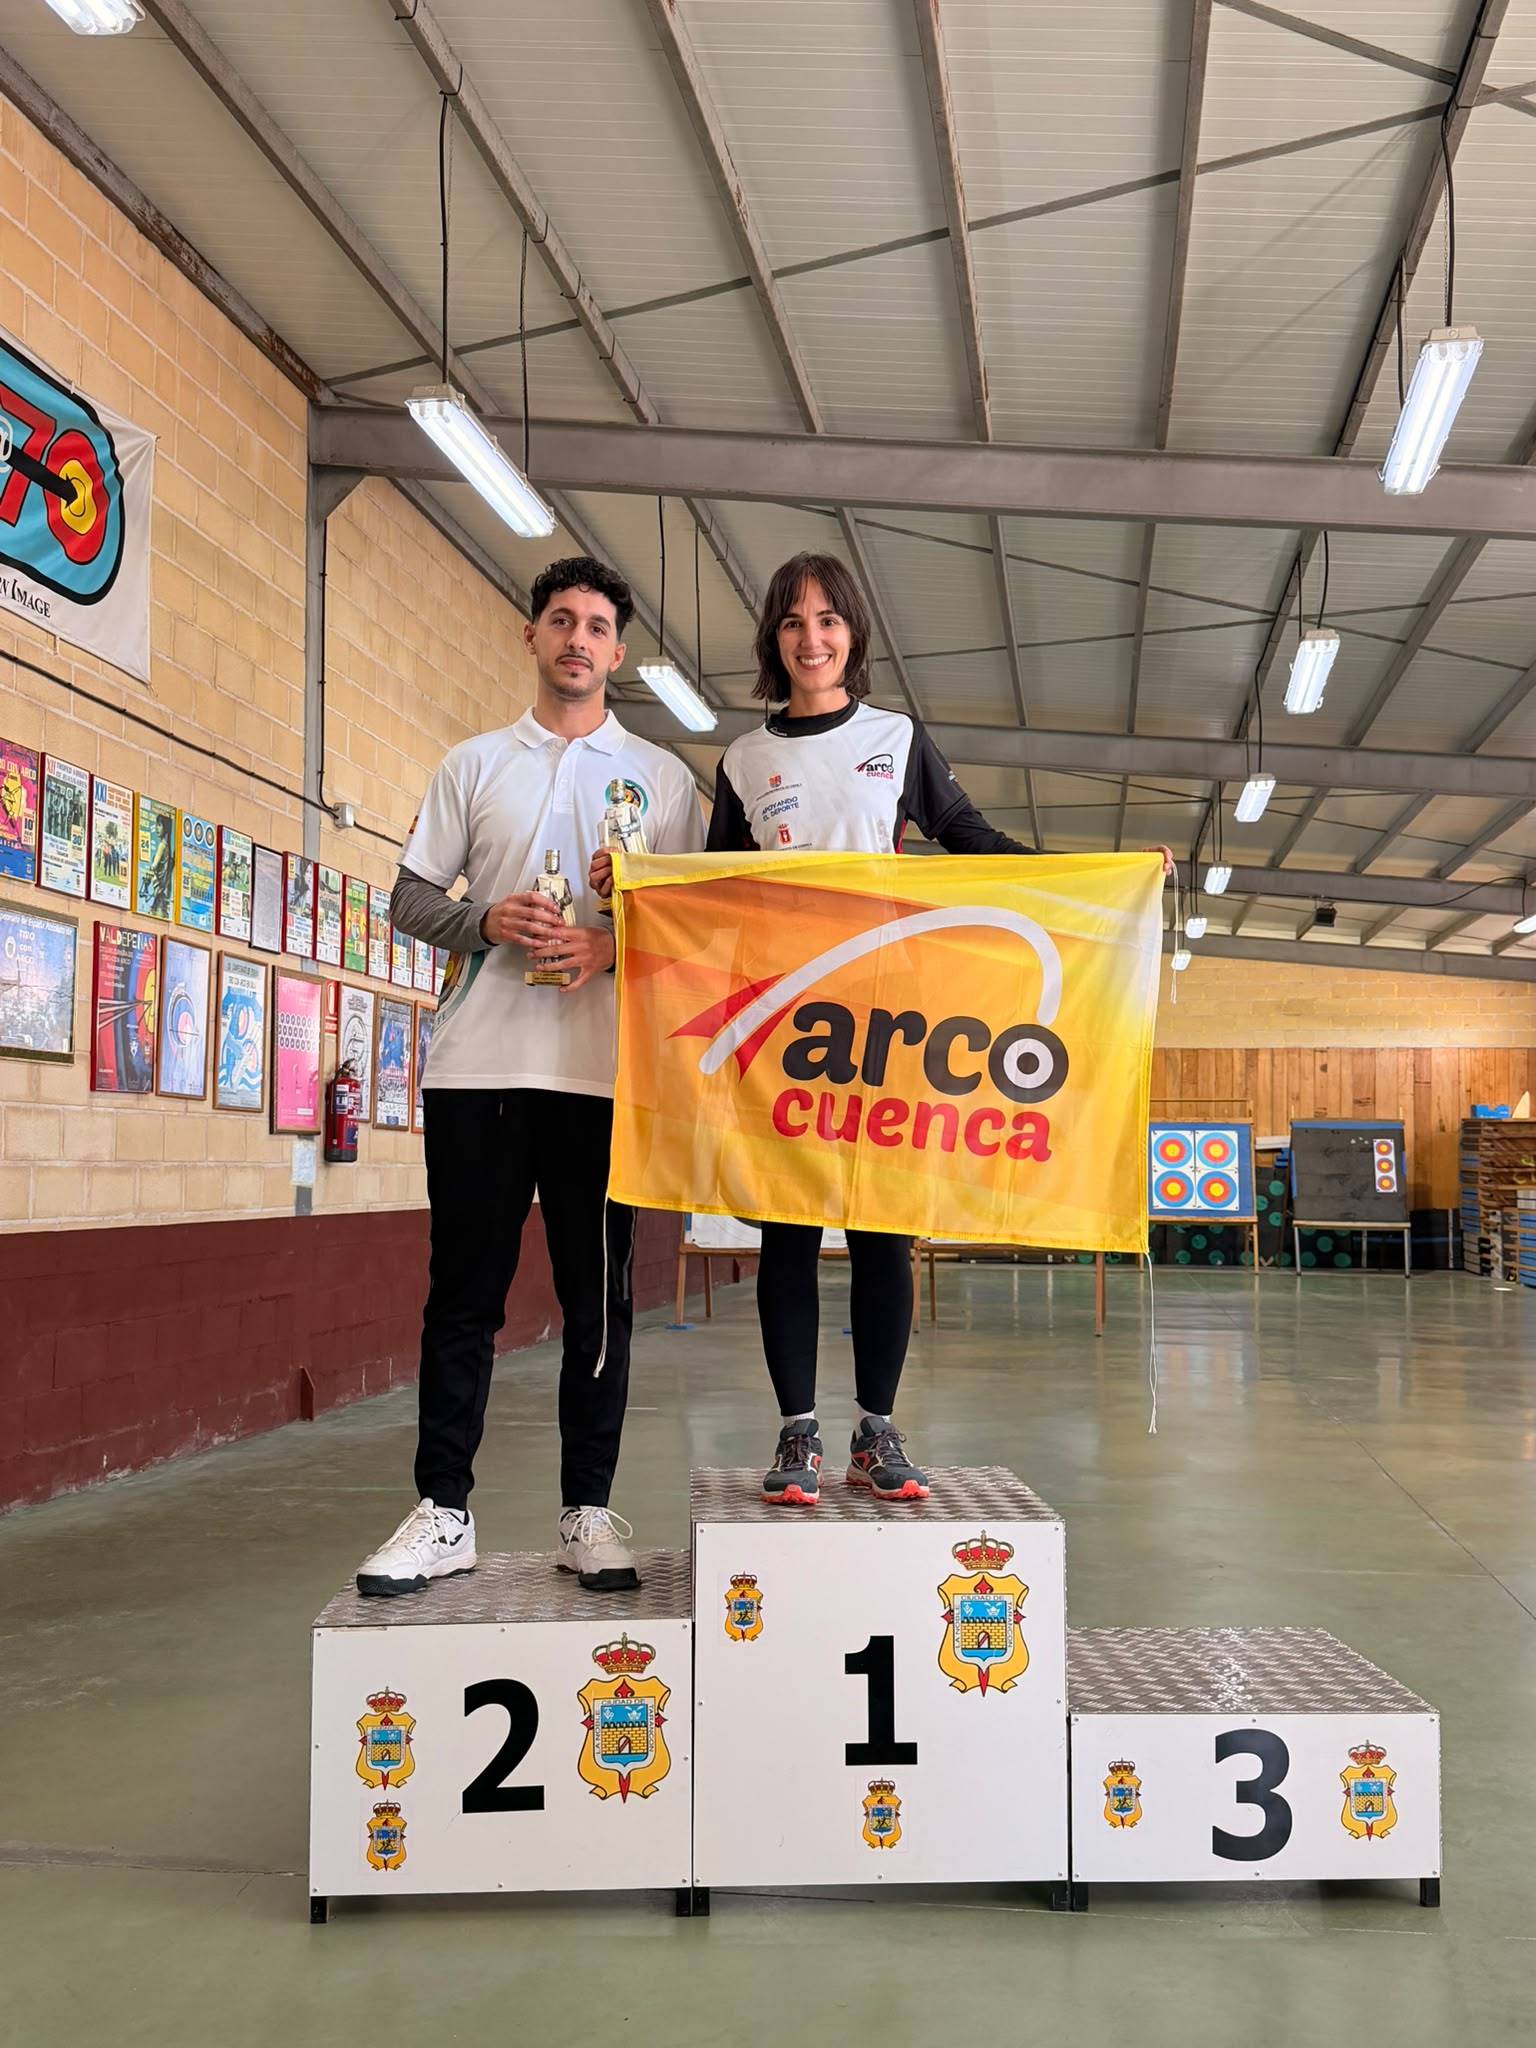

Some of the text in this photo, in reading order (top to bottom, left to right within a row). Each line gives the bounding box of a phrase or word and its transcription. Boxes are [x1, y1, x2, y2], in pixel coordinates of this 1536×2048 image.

[12, 578, 51, 618] IMAGE
[866, 762, 895, 774] arco
[866, 772, 894, 780] cuenca
[762, 796, 798, 815] APOYANDO
[770, 802, 799, 817] DEPORTE
[19, 930, 35, 941] TIRO
[20, 944, 32, 952] con
[100, 926, 154, 952] VALDEPEÑAS
[781, 1001, 1069, 1104] arco
[772, 1088, 1053, 1163] cuenca
[845, 1635, 918, 1766] 1
[462, 1678, 545, 1814] 2
[1212, 1728, 1293, 1862] 3
